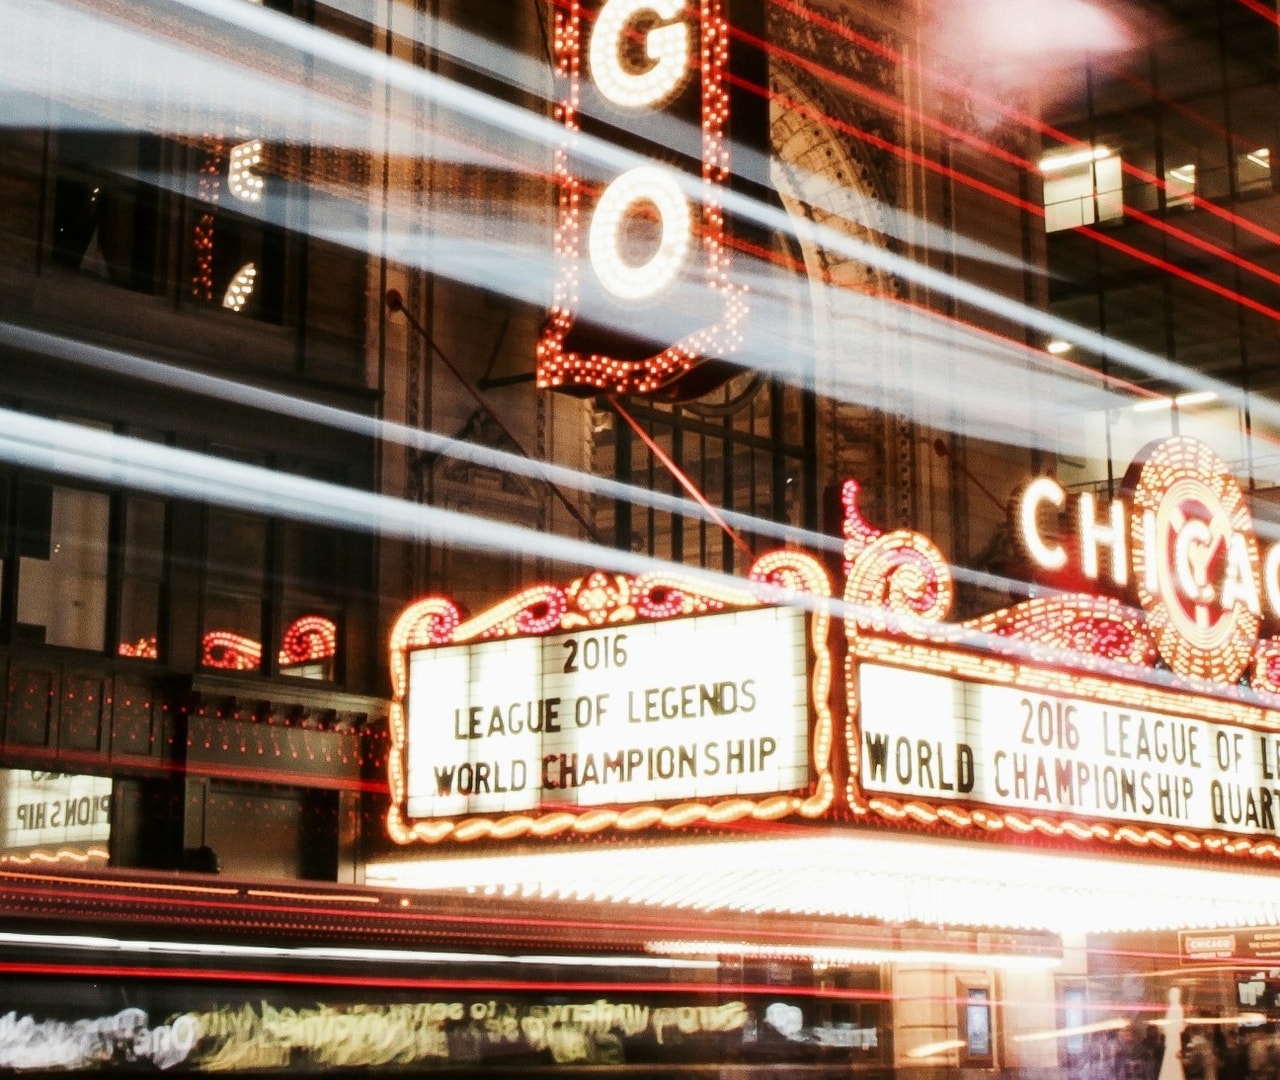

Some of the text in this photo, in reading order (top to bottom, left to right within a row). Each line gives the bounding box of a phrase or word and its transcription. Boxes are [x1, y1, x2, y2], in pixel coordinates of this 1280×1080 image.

[563, 633, 628, 673] 2016
[454, 678, 757, 741] LEAGUE OF LEGENDS
[1018, 697, 1081, 748] 2016
[1102, 712, 1202, 769] LEAGUE
[1216, 730, 1244, 770] OF
[433, 736, 777, 798] WORLD CHAMPIONSHIP
[863, 730, 975, 794] WORLD
[993, 750, 1194, 821] CHAMPIONSHIP
